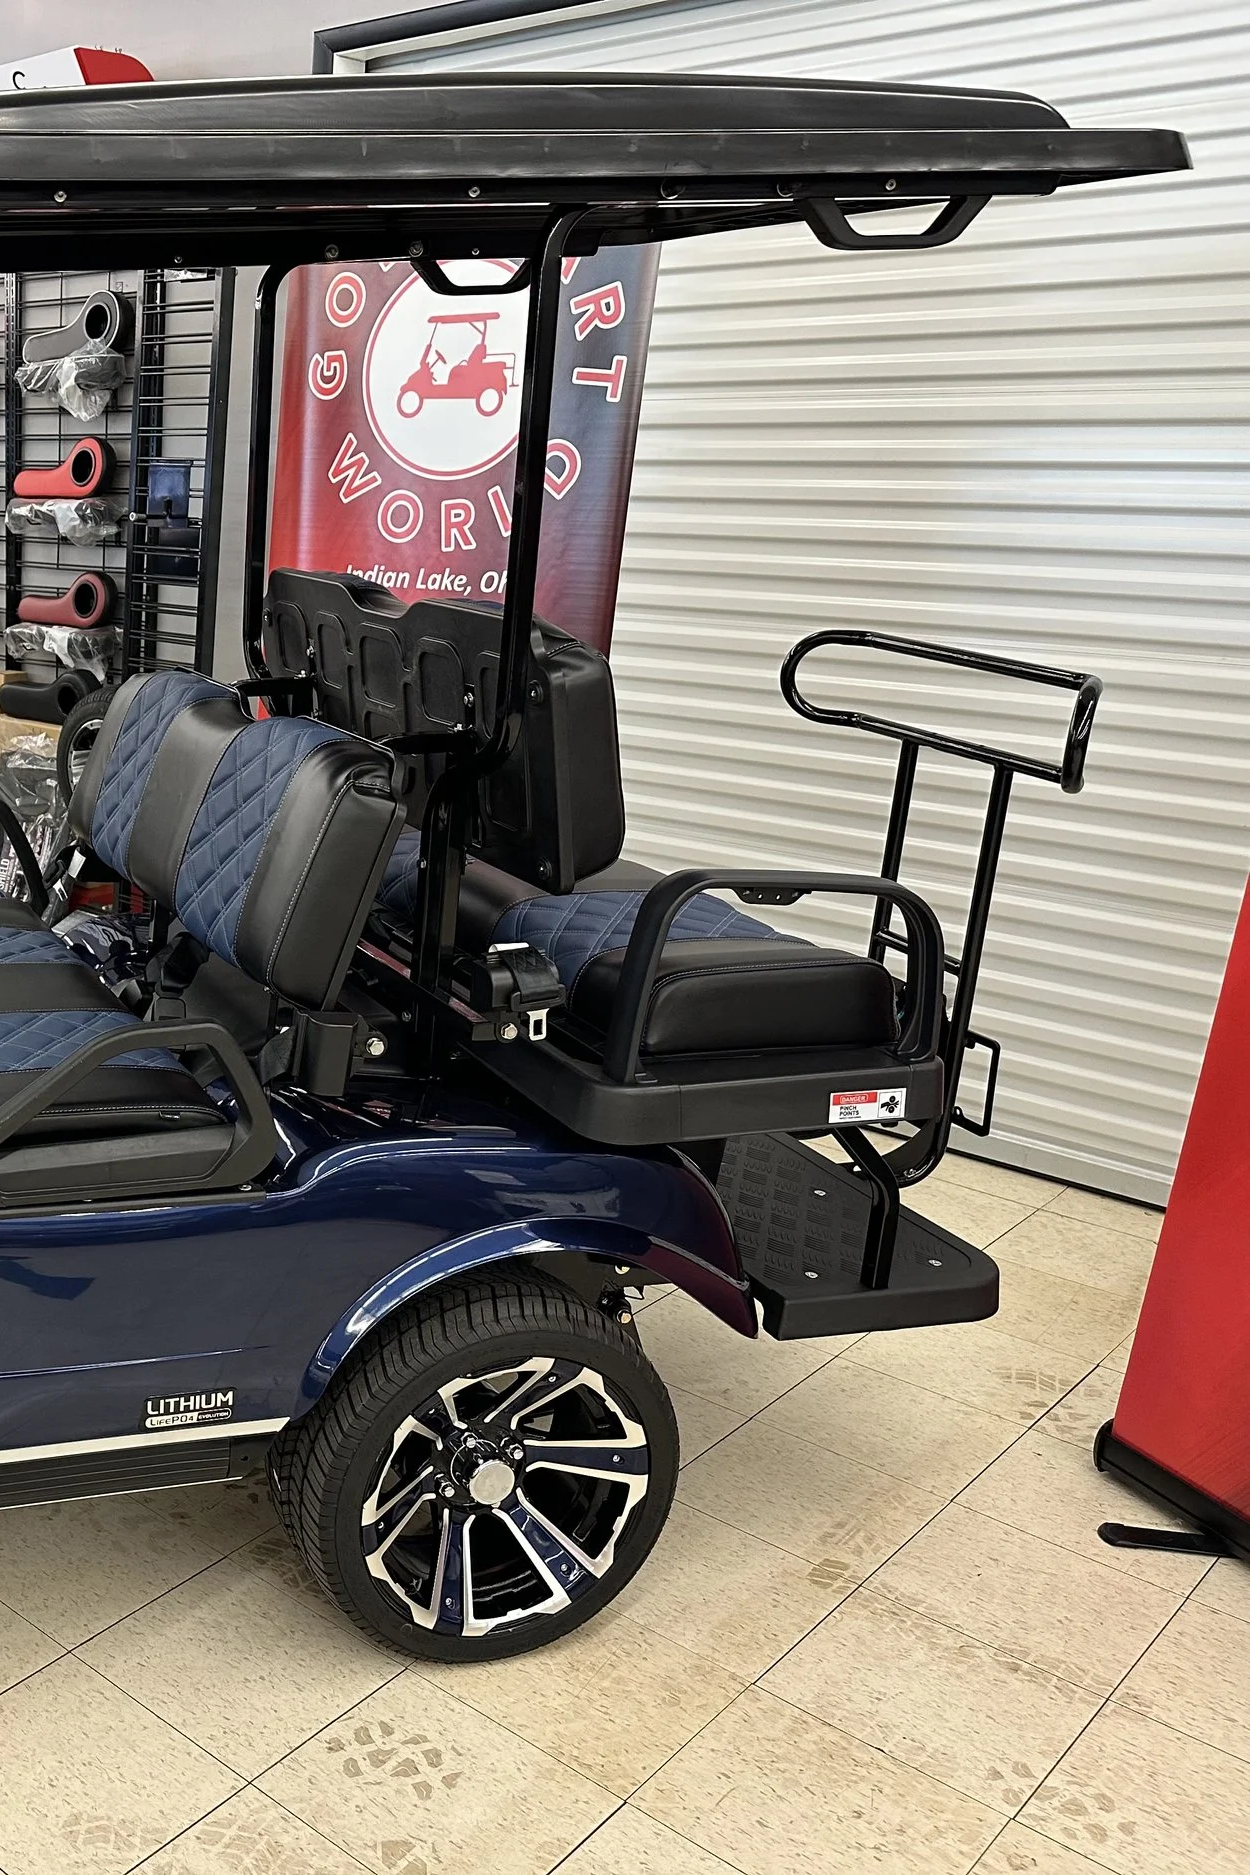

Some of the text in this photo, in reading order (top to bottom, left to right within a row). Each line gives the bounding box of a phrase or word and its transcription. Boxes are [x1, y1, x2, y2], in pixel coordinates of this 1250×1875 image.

[416, 567, 472, 596] Lake,
[841, 1095, 866, 1103] DANGER
[147, 1391, 234, 1414] LITHIUM
